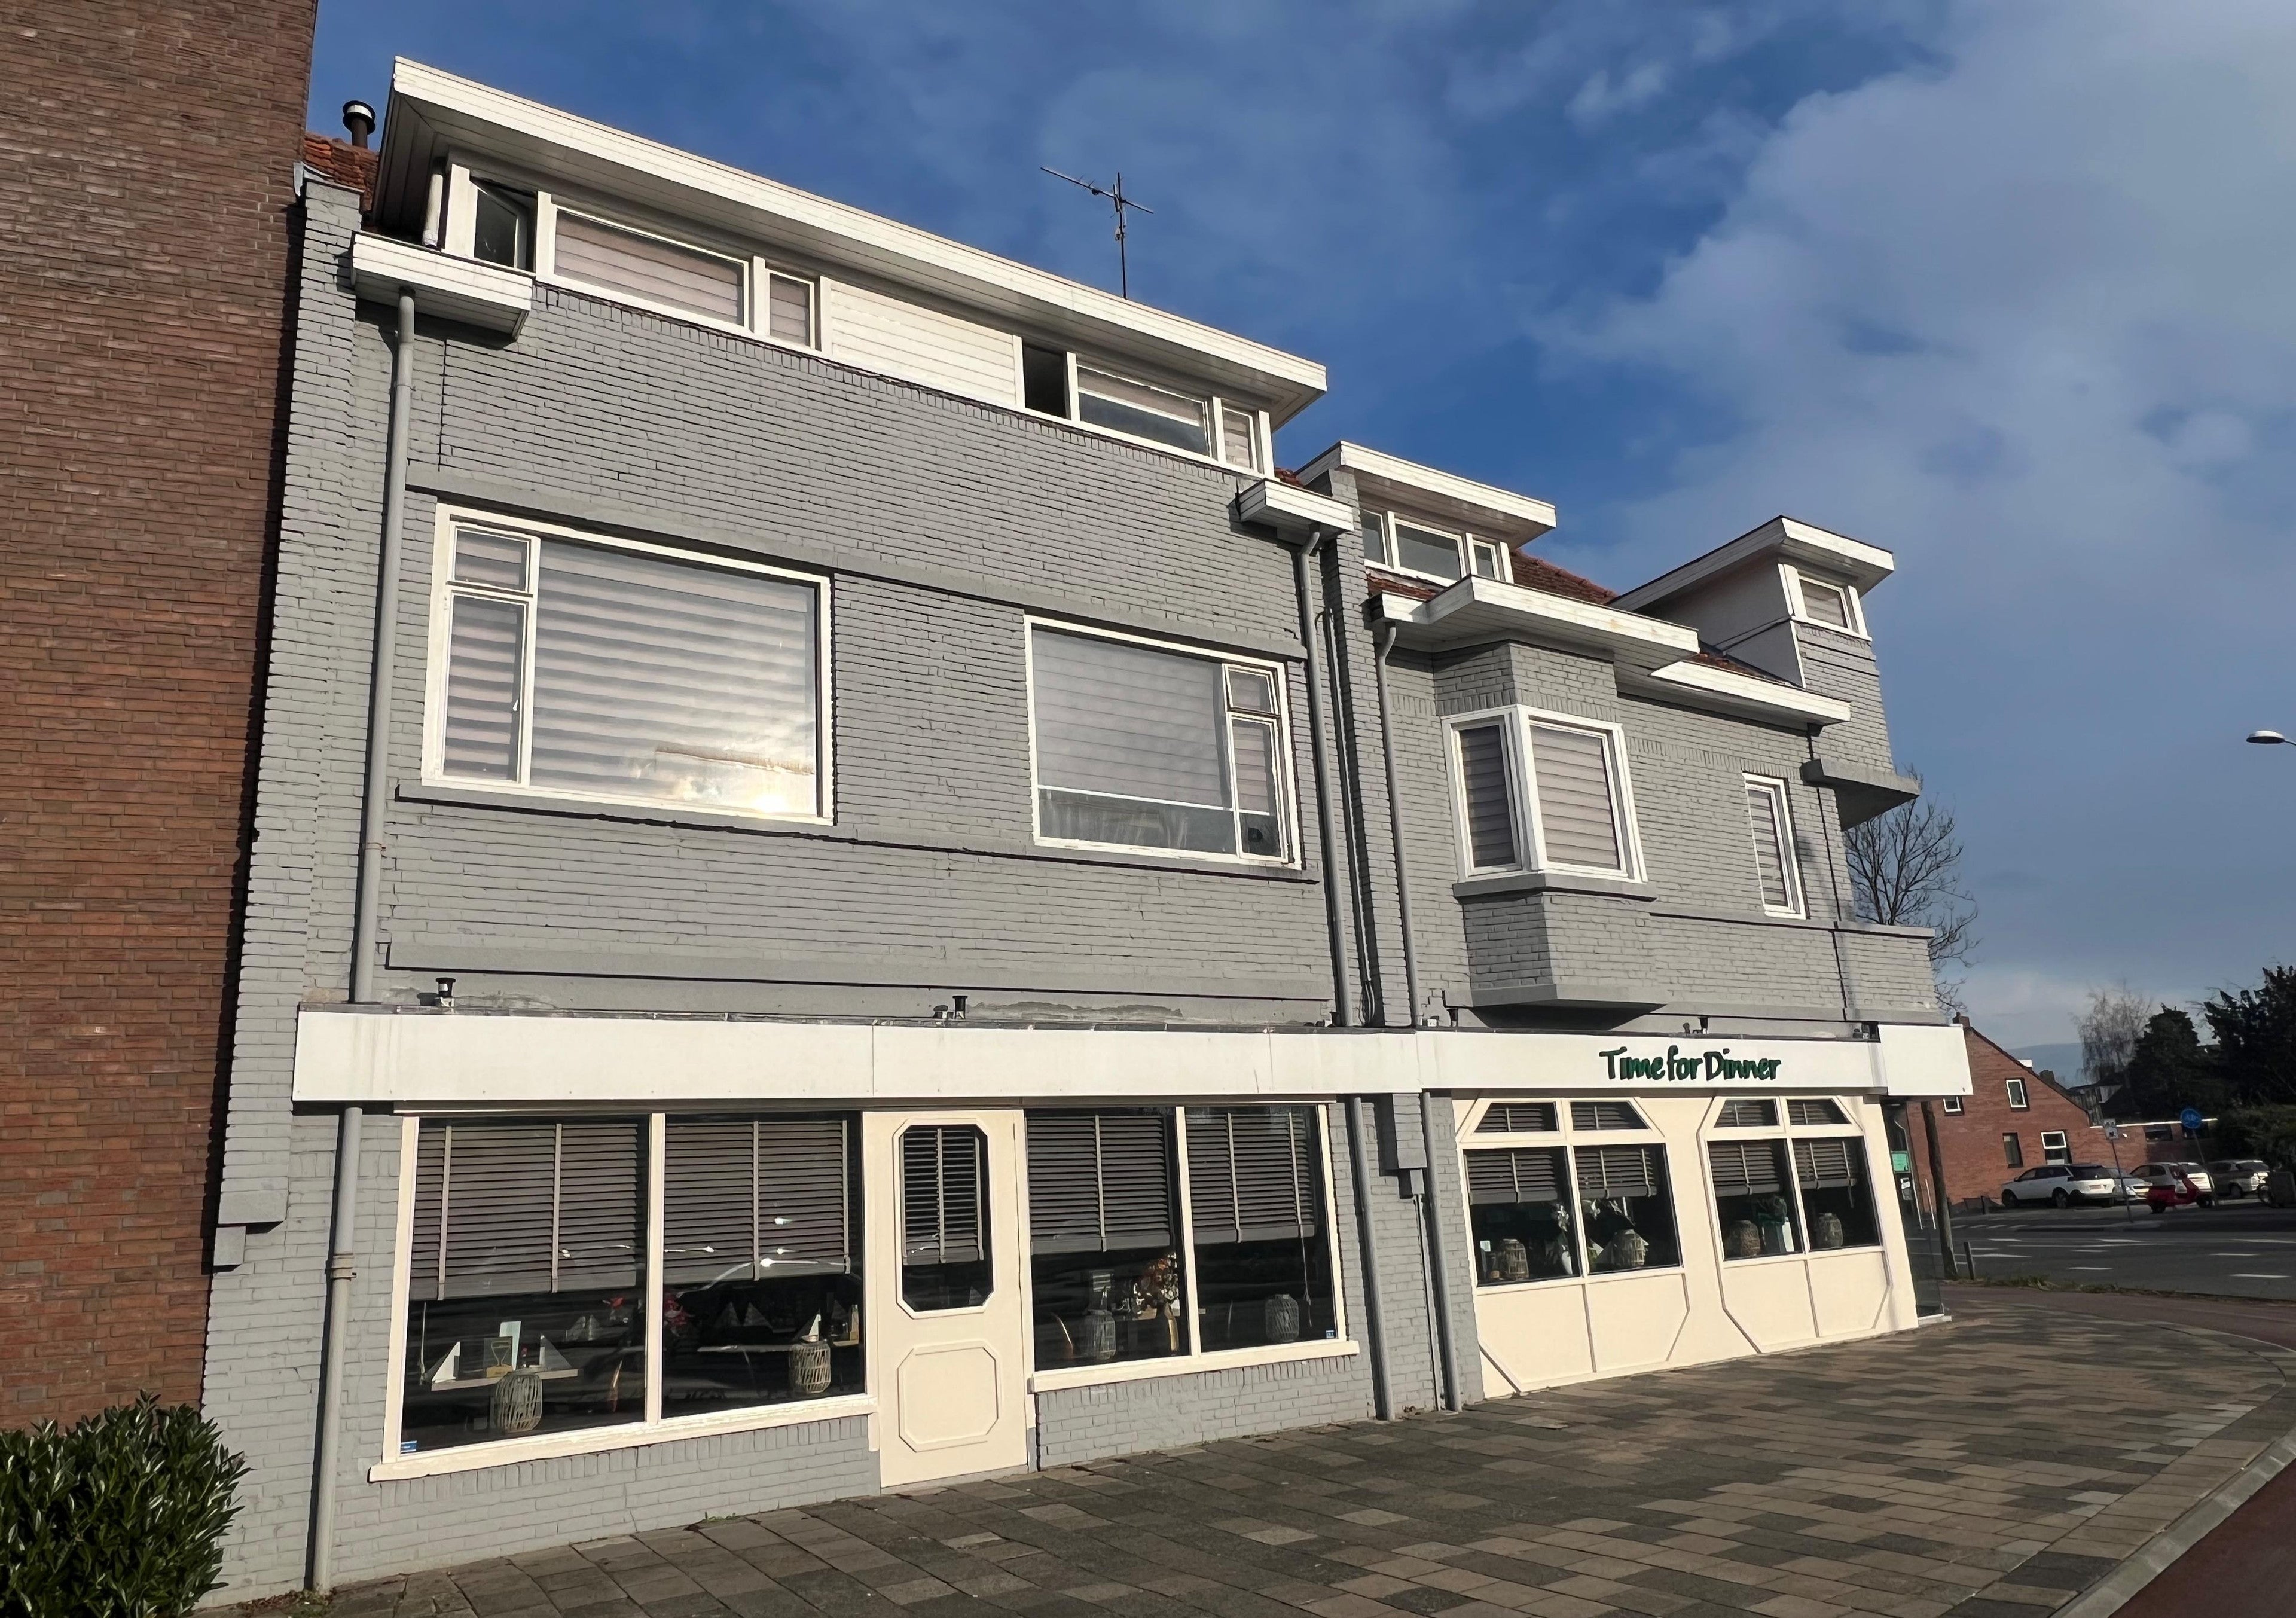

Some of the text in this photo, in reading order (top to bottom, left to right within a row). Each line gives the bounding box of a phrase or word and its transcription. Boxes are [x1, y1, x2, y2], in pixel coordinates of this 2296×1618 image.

[1599, 1045, 1781, 1081] Time for Dinner
